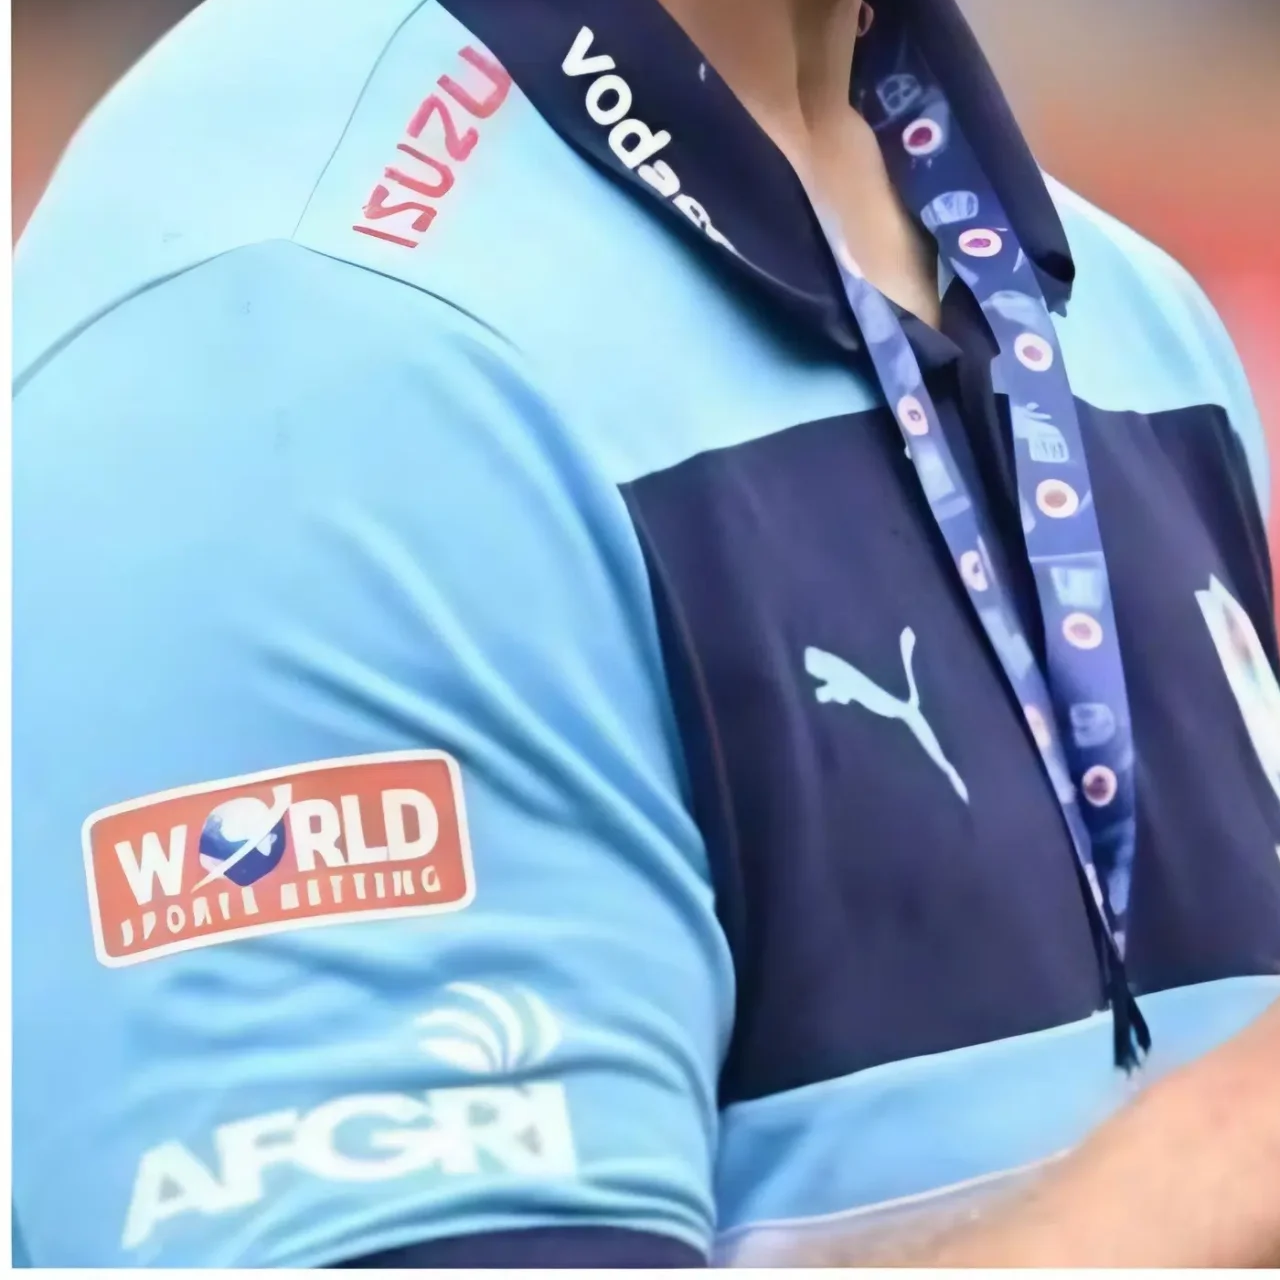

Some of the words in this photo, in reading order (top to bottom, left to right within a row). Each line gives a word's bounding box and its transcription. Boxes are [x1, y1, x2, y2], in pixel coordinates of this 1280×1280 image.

[352, 45, 512, 248] ISUZU
[114, 783, 439, 906] WORLD
[121, 1079, 578, 1250] AFGRI
